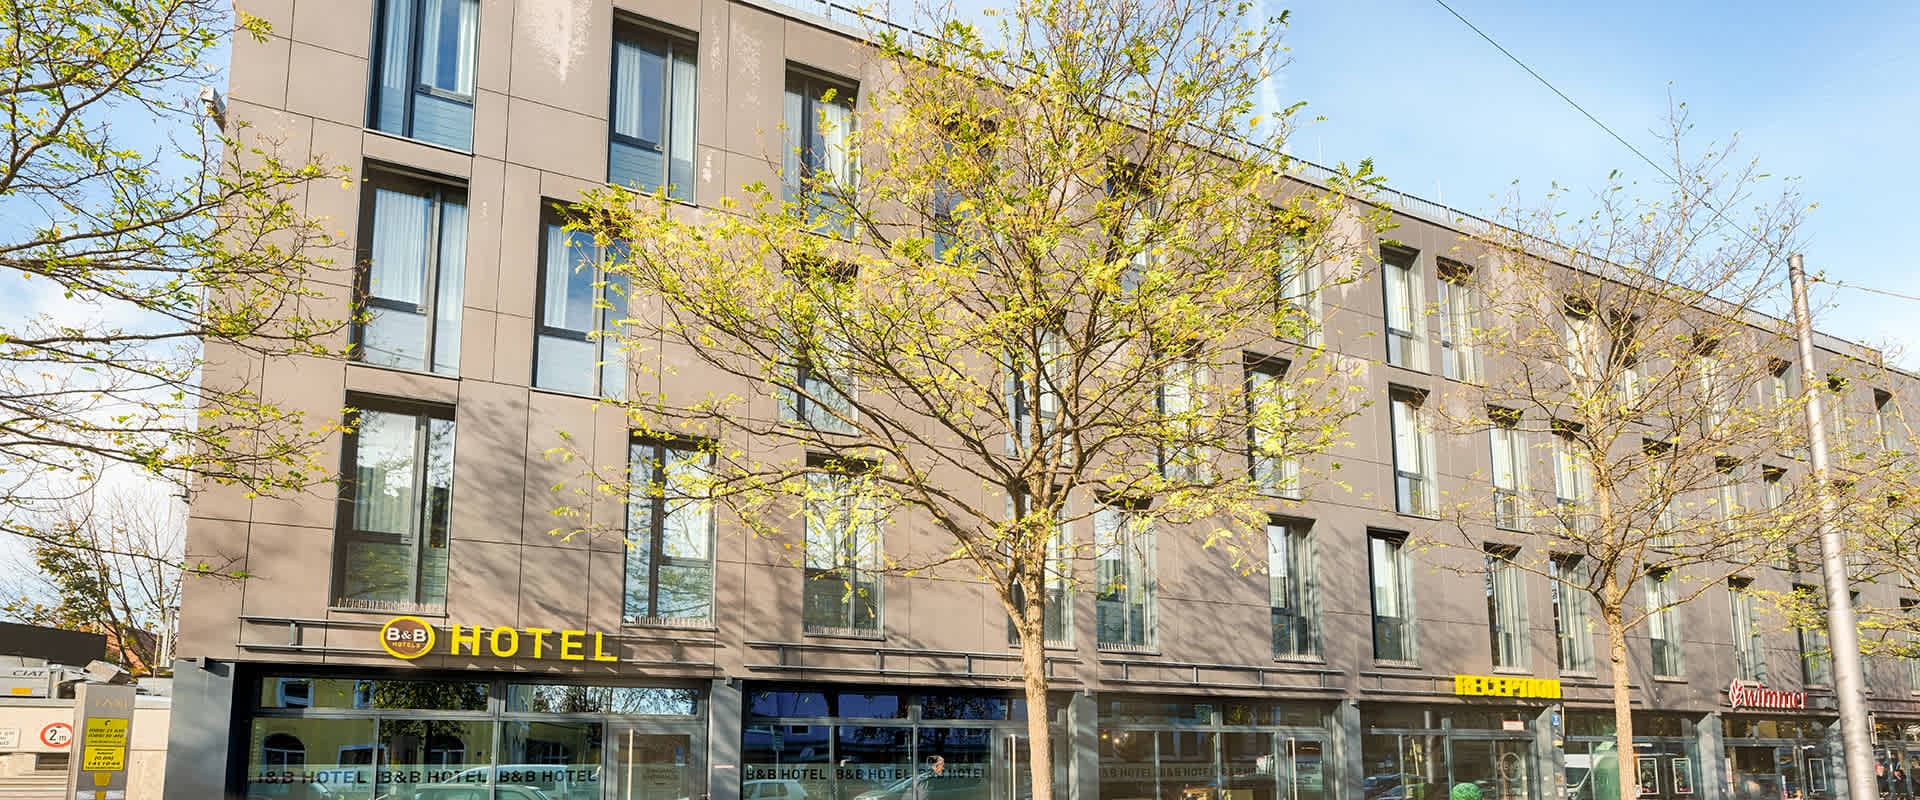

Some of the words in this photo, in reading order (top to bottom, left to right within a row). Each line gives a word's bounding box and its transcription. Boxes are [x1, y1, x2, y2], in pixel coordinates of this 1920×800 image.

[386, 627, 427, 643] B&B
[392, 641, 421, 649] HOTELS
[450, 624, 618, 662] HOTEL
[1455, 675, 1561, 699] RECEPTION
[1743, 684, 1807, 710] wimmer
[49, 728, 57, 741] 2
[302, 770, 367, 784] HOTEL
[381, 770, 421, 784] B&B
[427, 770, 487, 784] HOTEL
[499, 770, 536, 782] B&B
[542, 770, 597, 782] HOTEL
[745, 768, 777, 780] B&B
[781, 768, 827, 780] HOTEL
[836, 768, 864, 780] B&B
